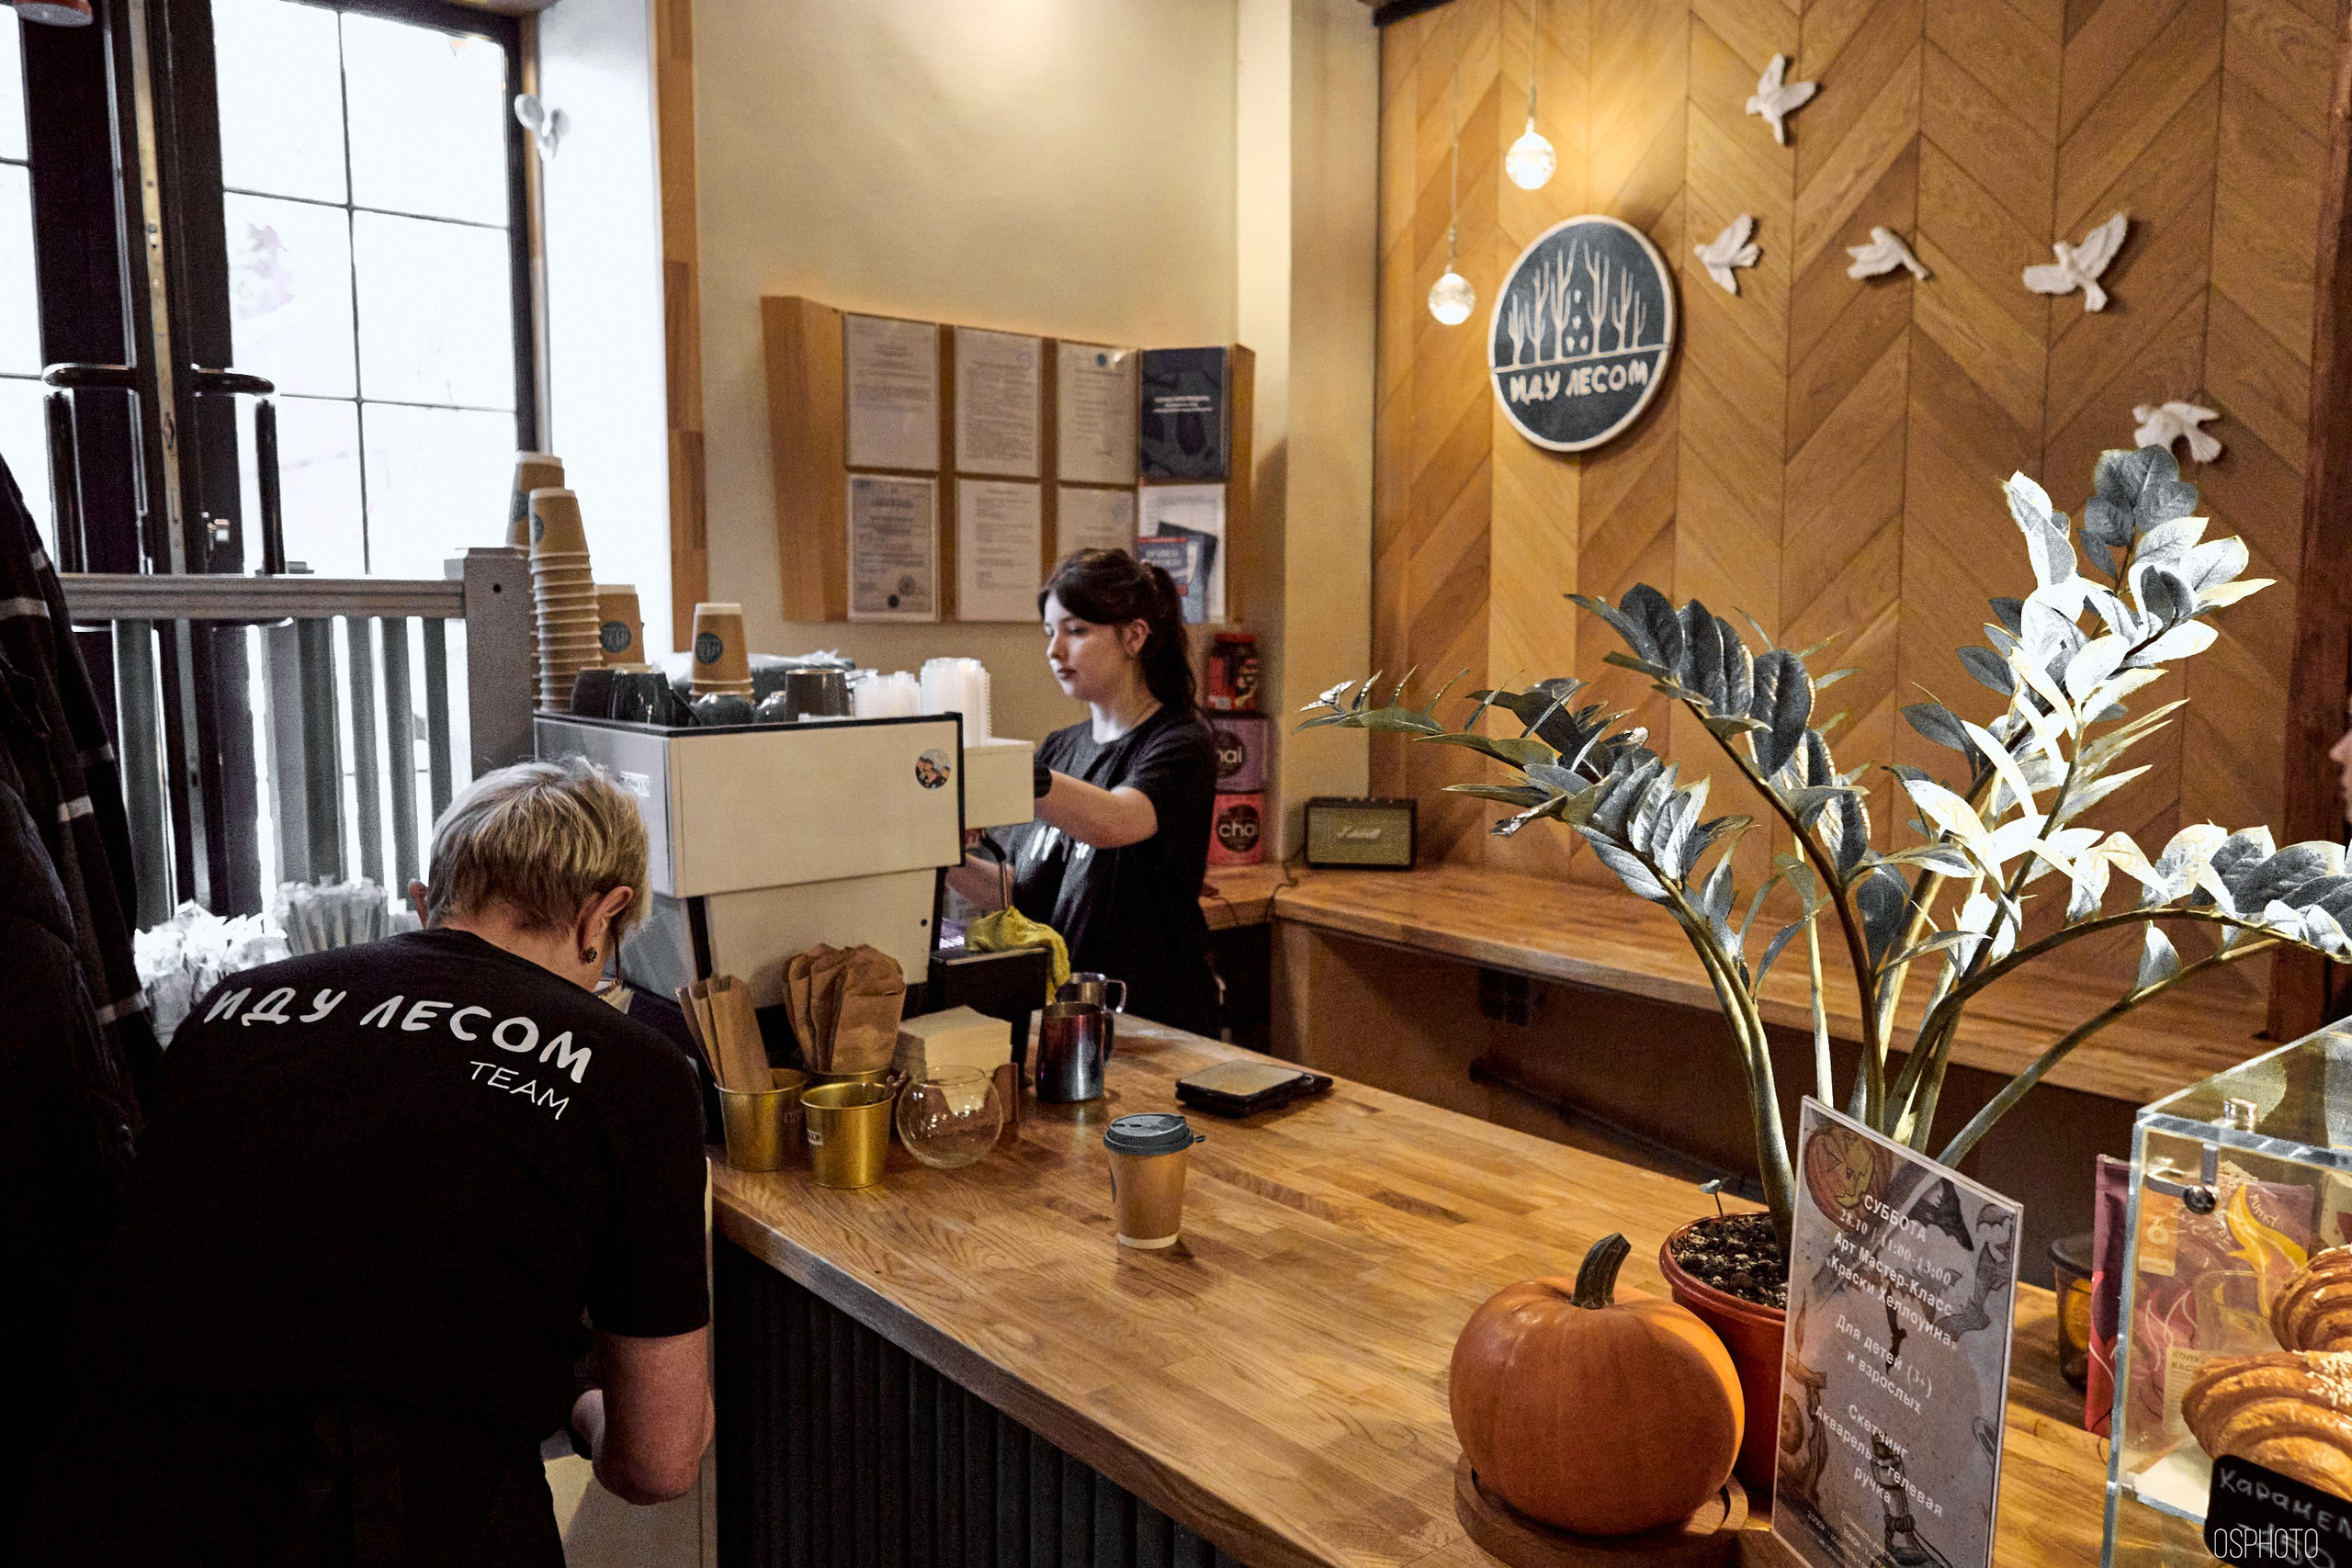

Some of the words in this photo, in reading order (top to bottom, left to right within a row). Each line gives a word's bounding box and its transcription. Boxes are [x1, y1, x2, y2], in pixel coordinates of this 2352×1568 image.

[1510, 370, 1560, 405] ИДУ
[1565, 358, 1648, 397] ЛЕСОМ
[204, 987, 347, 1027] ИДУ
[359, 995, 593, 1084] ЛЕСОМ
[469, 1060, 571, 1121] TEAM
[1839, 1208, 1869, 1235] 28.10
[1880, 1233, 1952, 1286] 11:00-13:00
[1864, 1193, 1927, 1243] СУББОТА
[1826, 1255, 1875, 1295] «Краски
[1877, 1289, 1959, 1352] Хеллоуина»
[1834, 1231, 1856, 1255] Арт
[1859, 1246, 1953, 1316] Мастер-Класс
[1836, 1314, 1860, 1341] Для
[1863, 1336, 1904, 1371] детей
[1847, 1350, 1856, 1364] и
[1858, 1359, 1922, 1416] взрослых
[1815, 1404, 1873, 1461] Акварель
[1887, 1466, 1944, 1518] гелевая
[1849, 1404, 1909, 1460] Скетчинг
[1854, 1467, 1893, 1505] ручка
